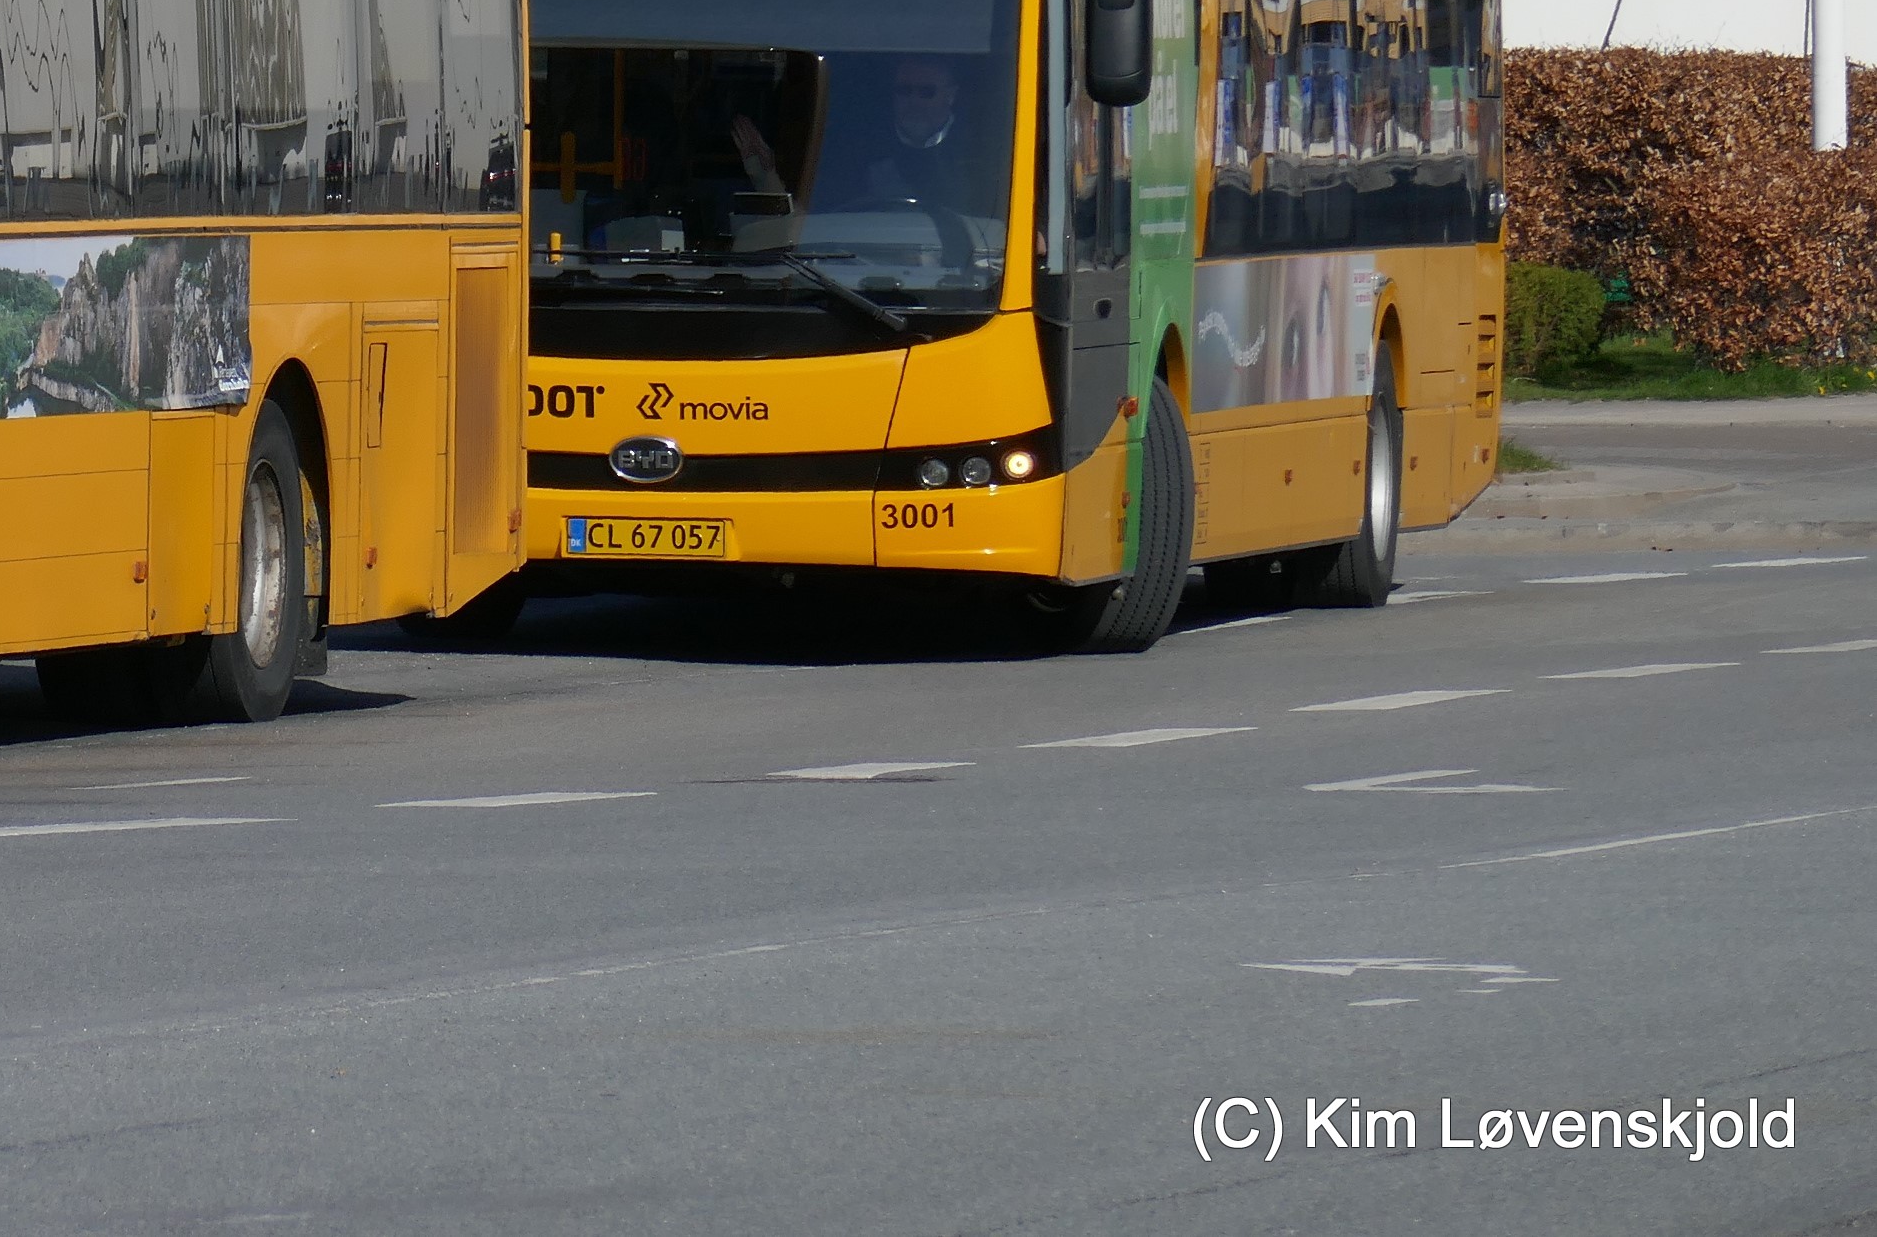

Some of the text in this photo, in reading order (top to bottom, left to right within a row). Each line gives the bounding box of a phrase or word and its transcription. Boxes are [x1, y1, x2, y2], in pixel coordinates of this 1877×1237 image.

[679, 396, 769, 421] movia
[618, 450, 674, 468] BYD
[881, 502, 954, 529] 3001
[588, 523, 622, 548] CL
[631, 523, 663, 549] 67
[672, 524, 721, 550] 057
